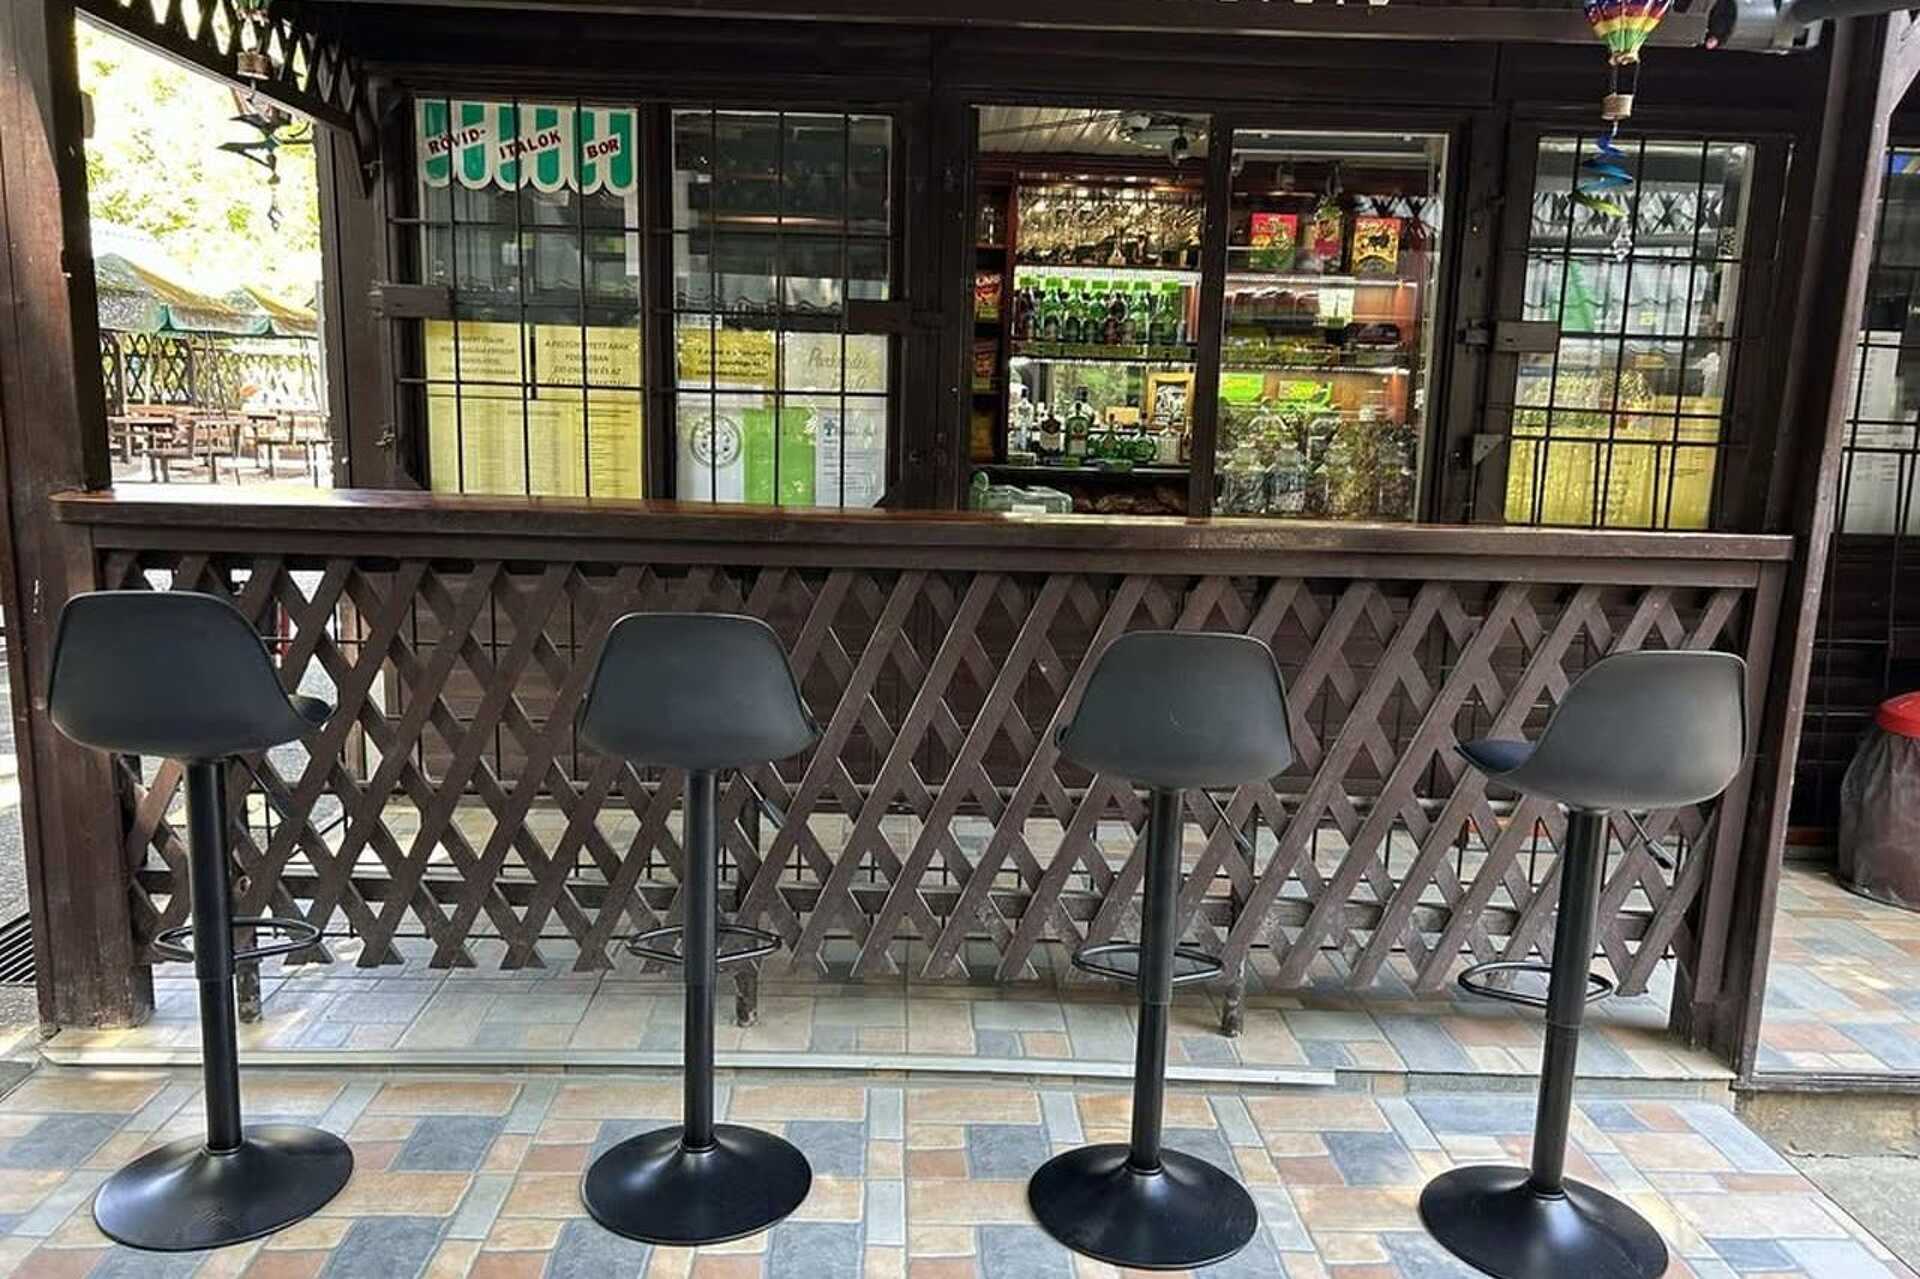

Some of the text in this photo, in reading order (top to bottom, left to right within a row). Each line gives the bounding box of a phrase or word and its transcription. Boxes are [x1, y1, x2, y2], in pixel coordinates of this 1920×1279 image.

[428, 128, 620, 159] RÖVID- ITALOK BOR
